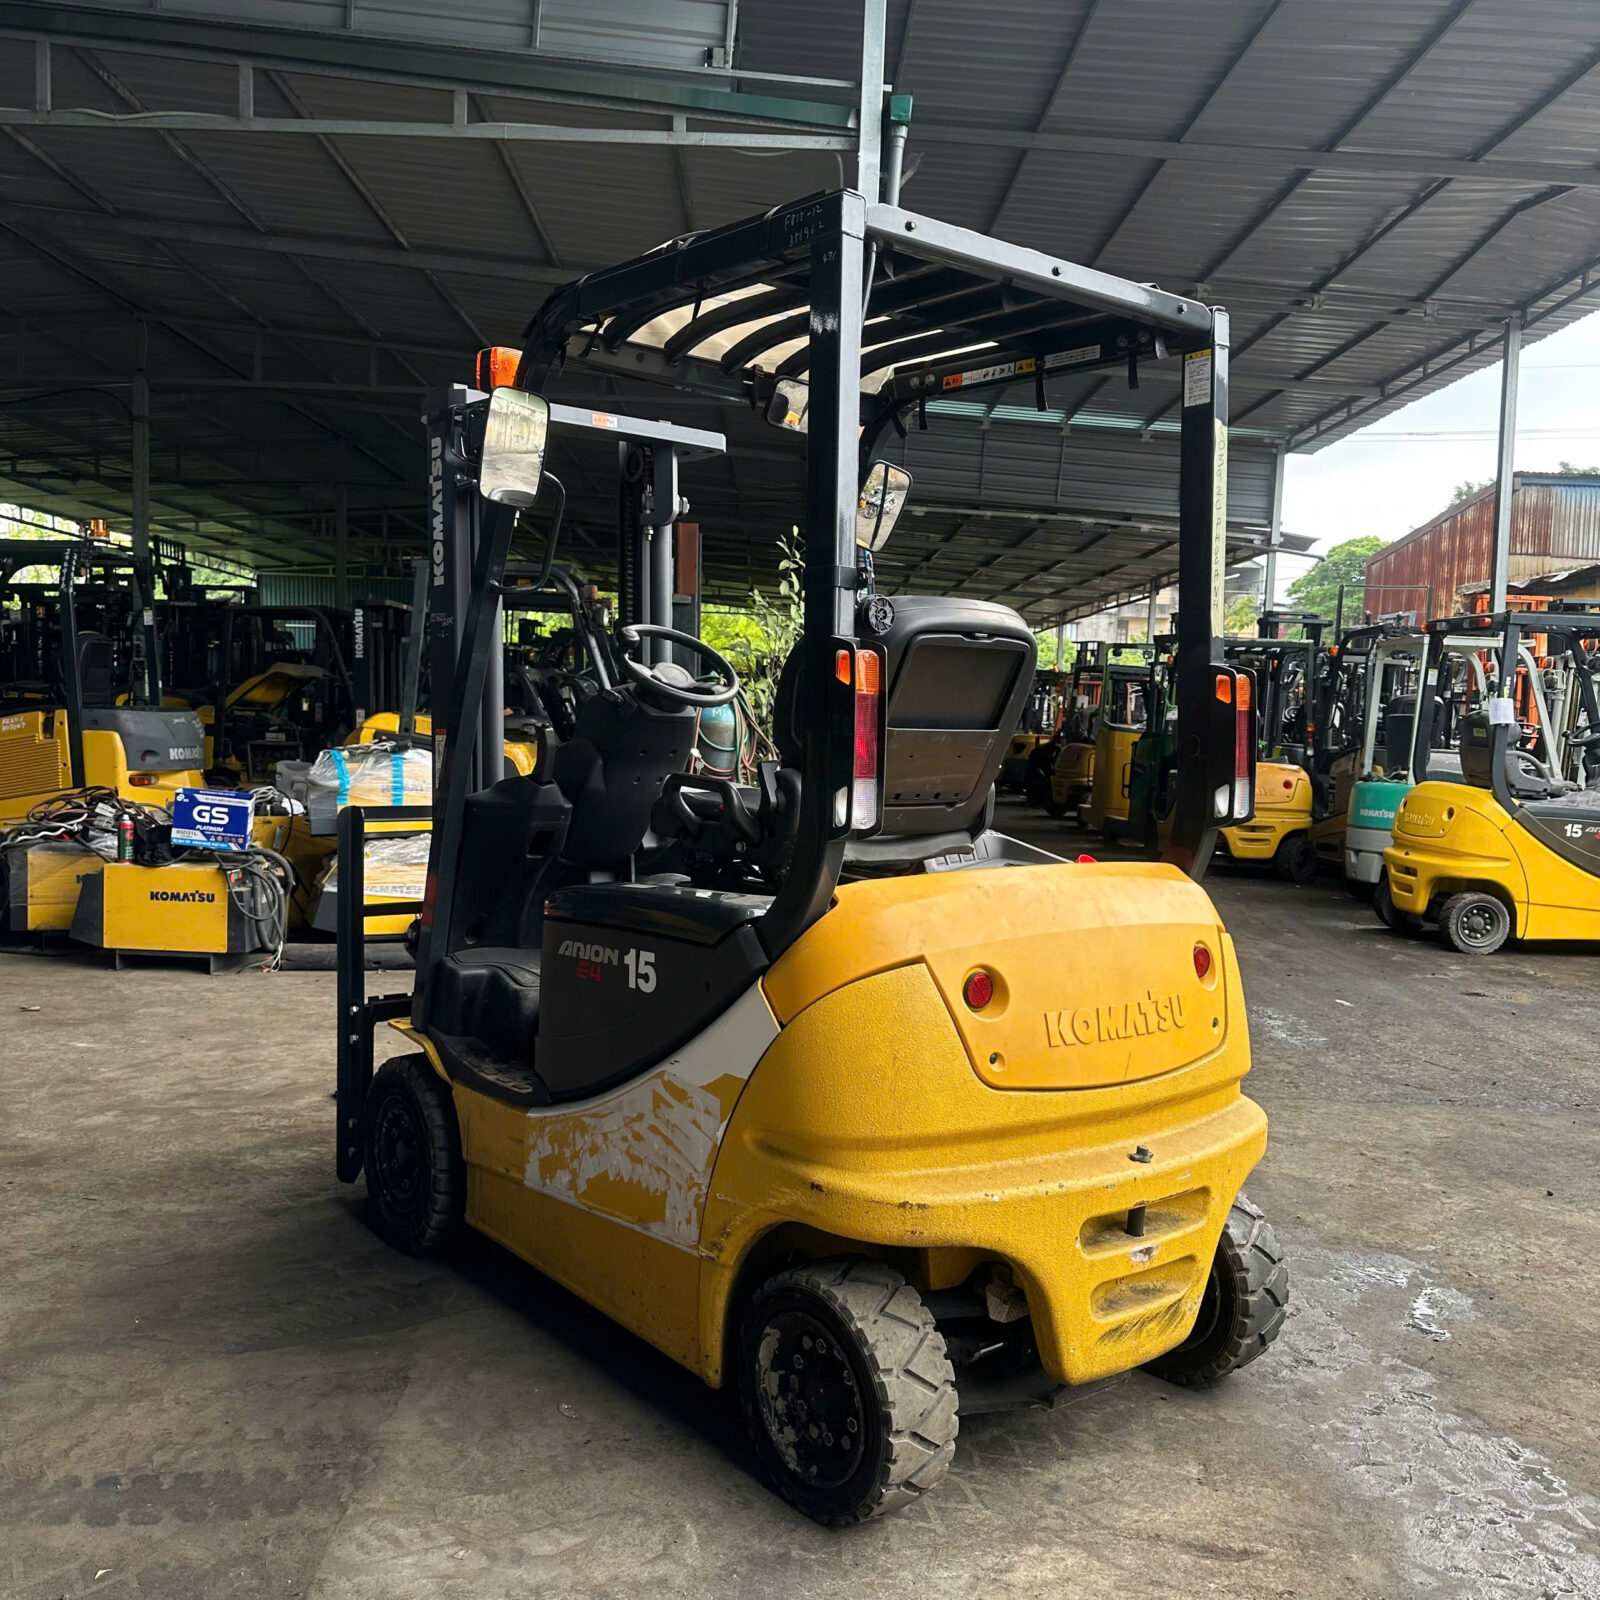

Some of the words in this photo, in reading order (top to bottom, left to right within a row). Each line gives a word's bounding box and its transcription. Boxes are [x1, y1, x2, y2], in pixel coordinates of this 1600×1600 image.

[429, 435, 446, 587] KOMATSU
[353, 608, 364, 659] KOMATSU
[192, 804, 230, 825] GS
[1360, 808, 1395, 819] KOMATSU
[195, 824, 224, 832] PLATINUM
[1564, 823, 1583, 838] 15
[150, 890, 215, 903] KOMATSU
[624, 948, 657, 993] 15
[1044, 989, 1187, 1048] KOMATSU
